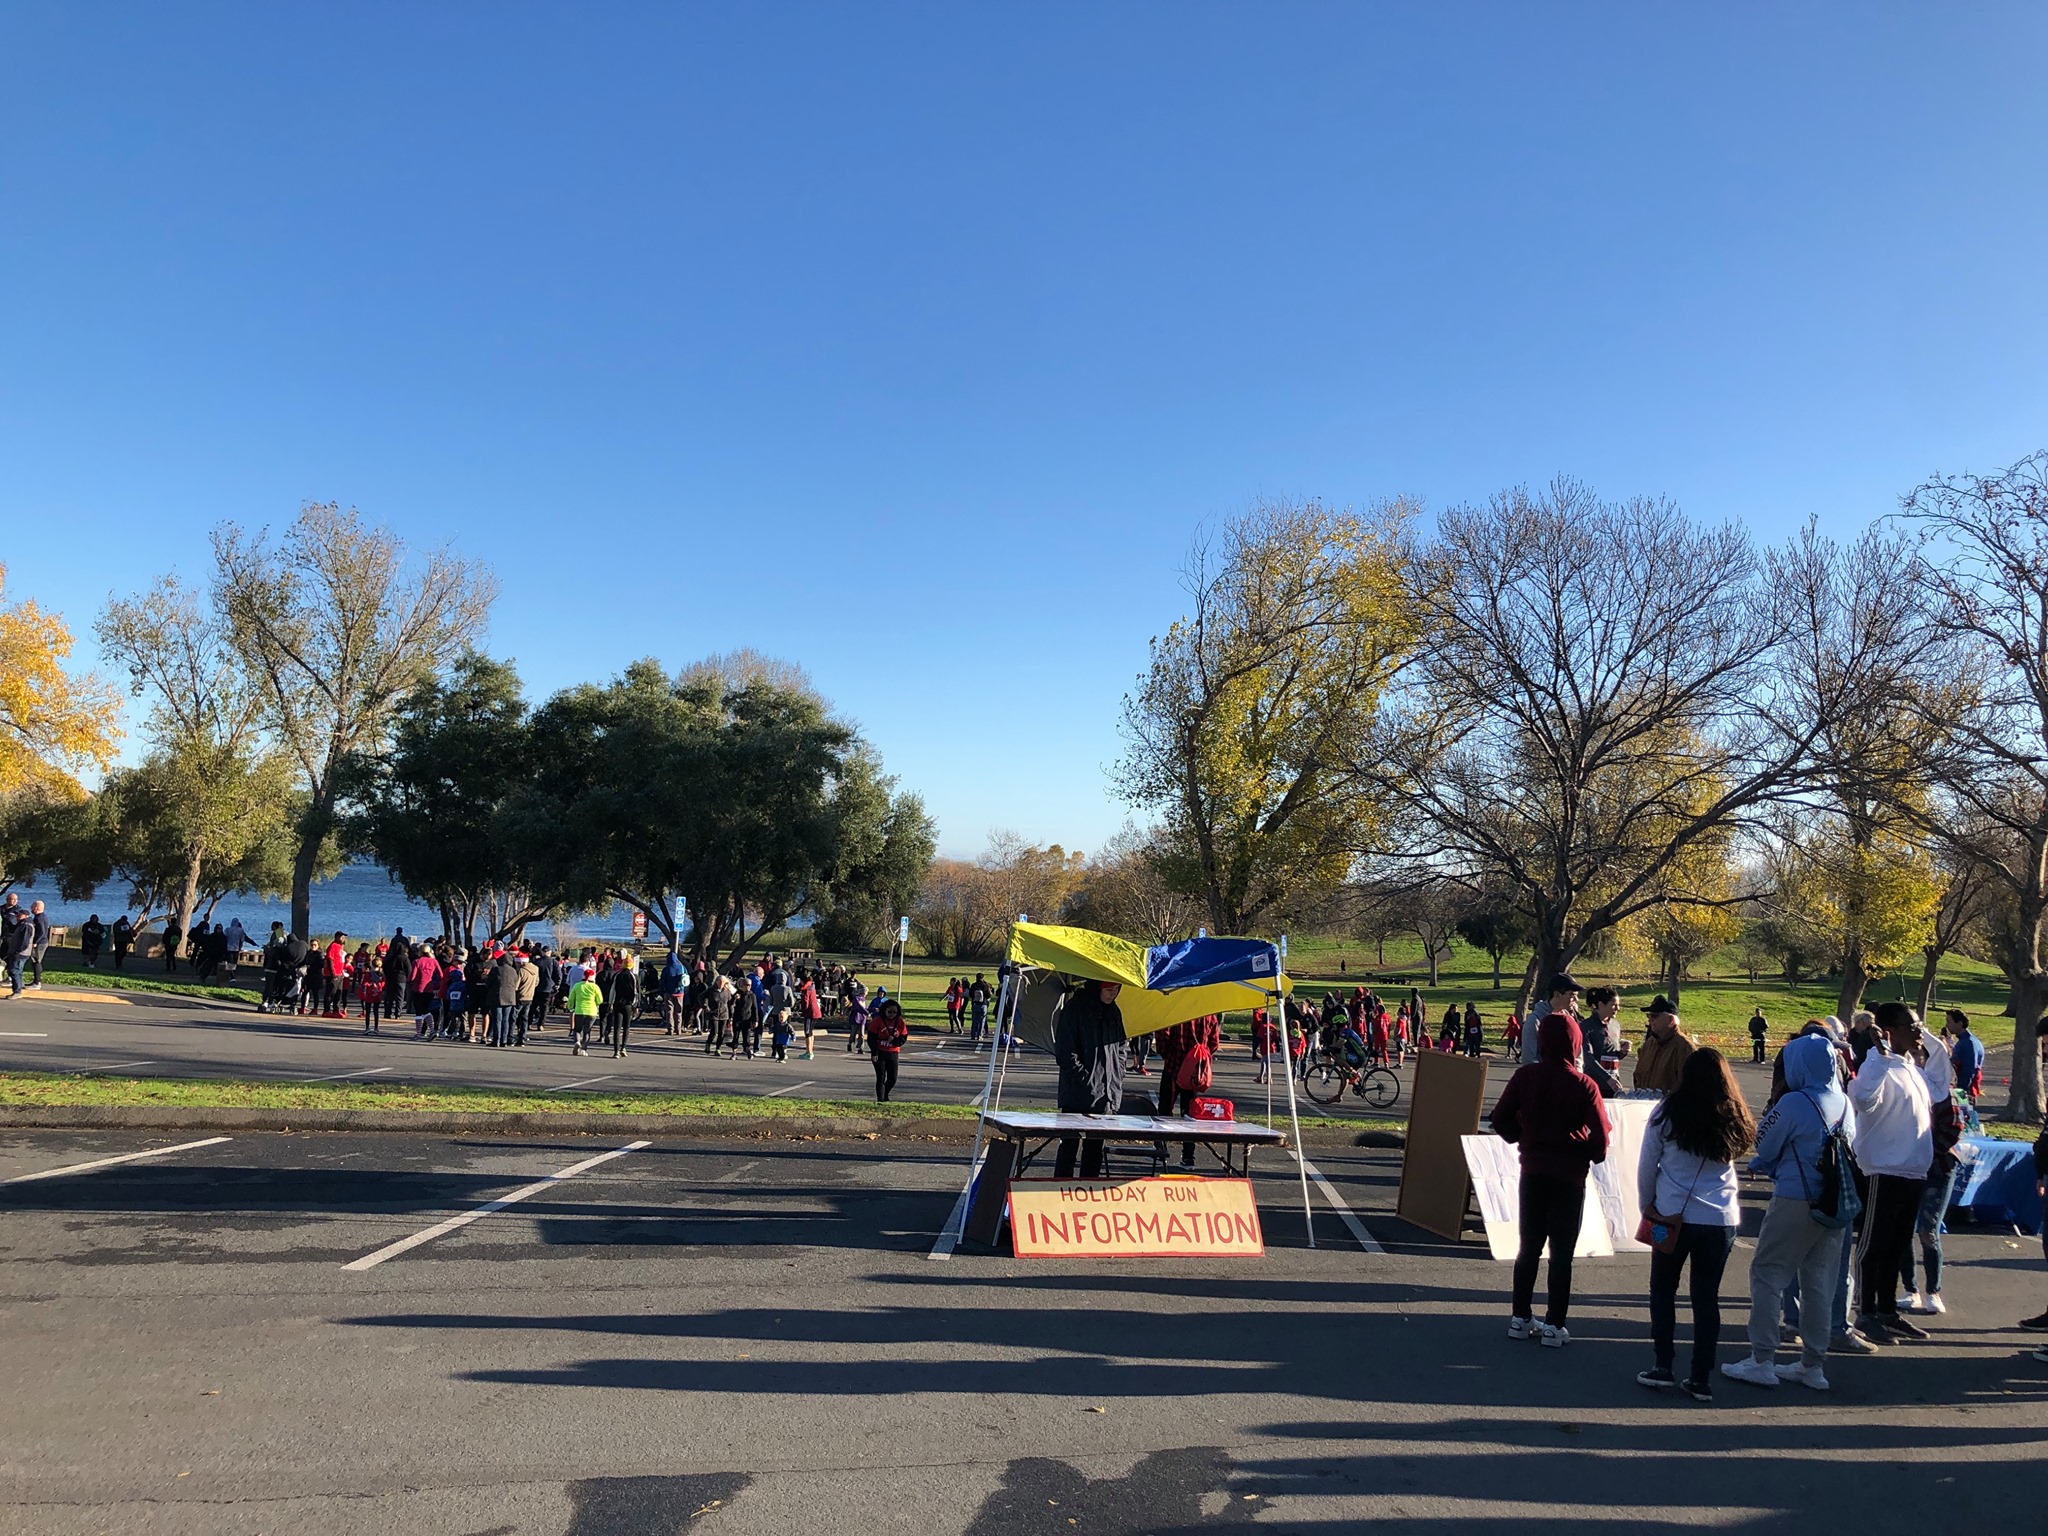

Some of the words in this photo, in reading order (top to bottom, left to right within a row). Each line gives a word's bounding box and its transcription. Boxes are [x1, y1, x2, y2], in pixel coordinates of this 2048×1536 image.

[1060, 1186, 1147, 1203] HOLIDAY
[1165, 1186, 1198, 1202] RUN
[1028, 1212, 1258, 1245] INFORMATION
